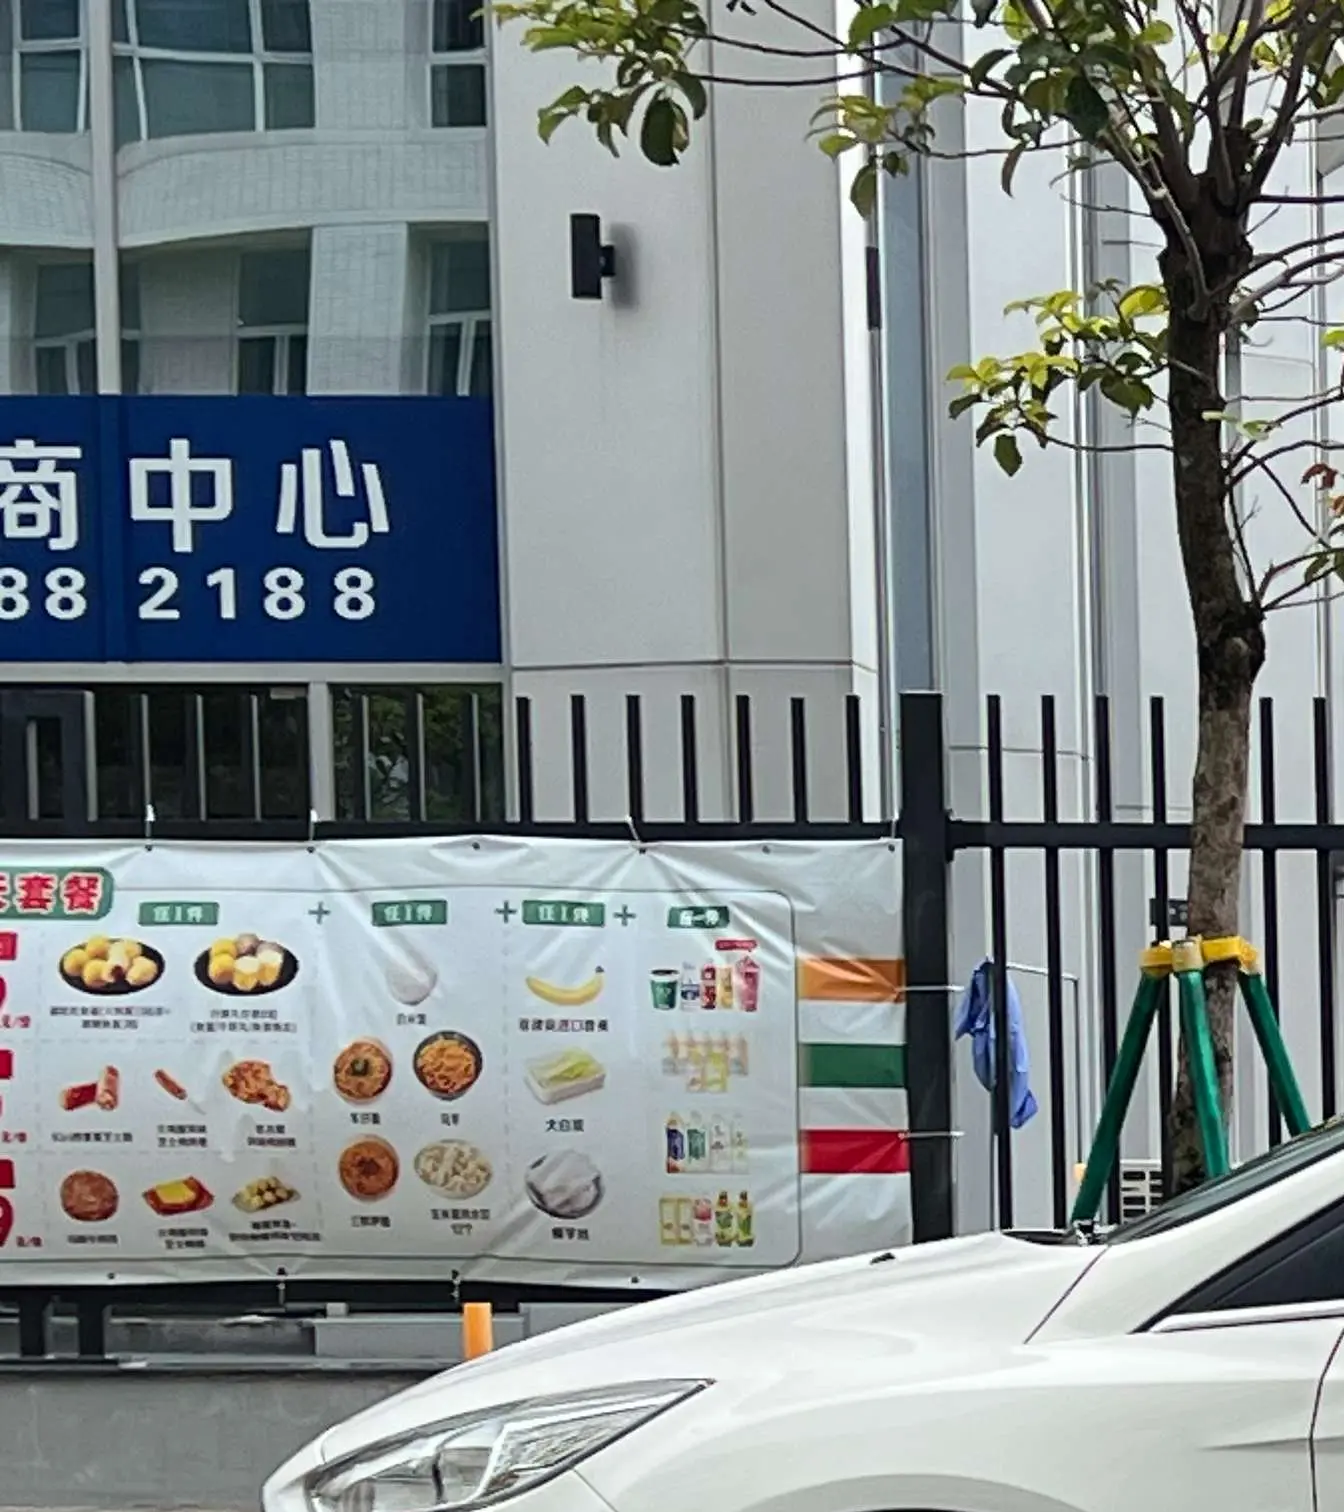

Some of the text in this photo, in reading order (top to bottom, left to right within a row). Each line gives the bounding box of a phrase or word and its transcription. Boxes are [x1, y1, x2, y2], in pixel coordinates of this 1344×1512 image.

[0, 438, 390, 553] 商中心
[138, 567, 376, 621] 2188
[0, 873, 103, 914] 套餐
